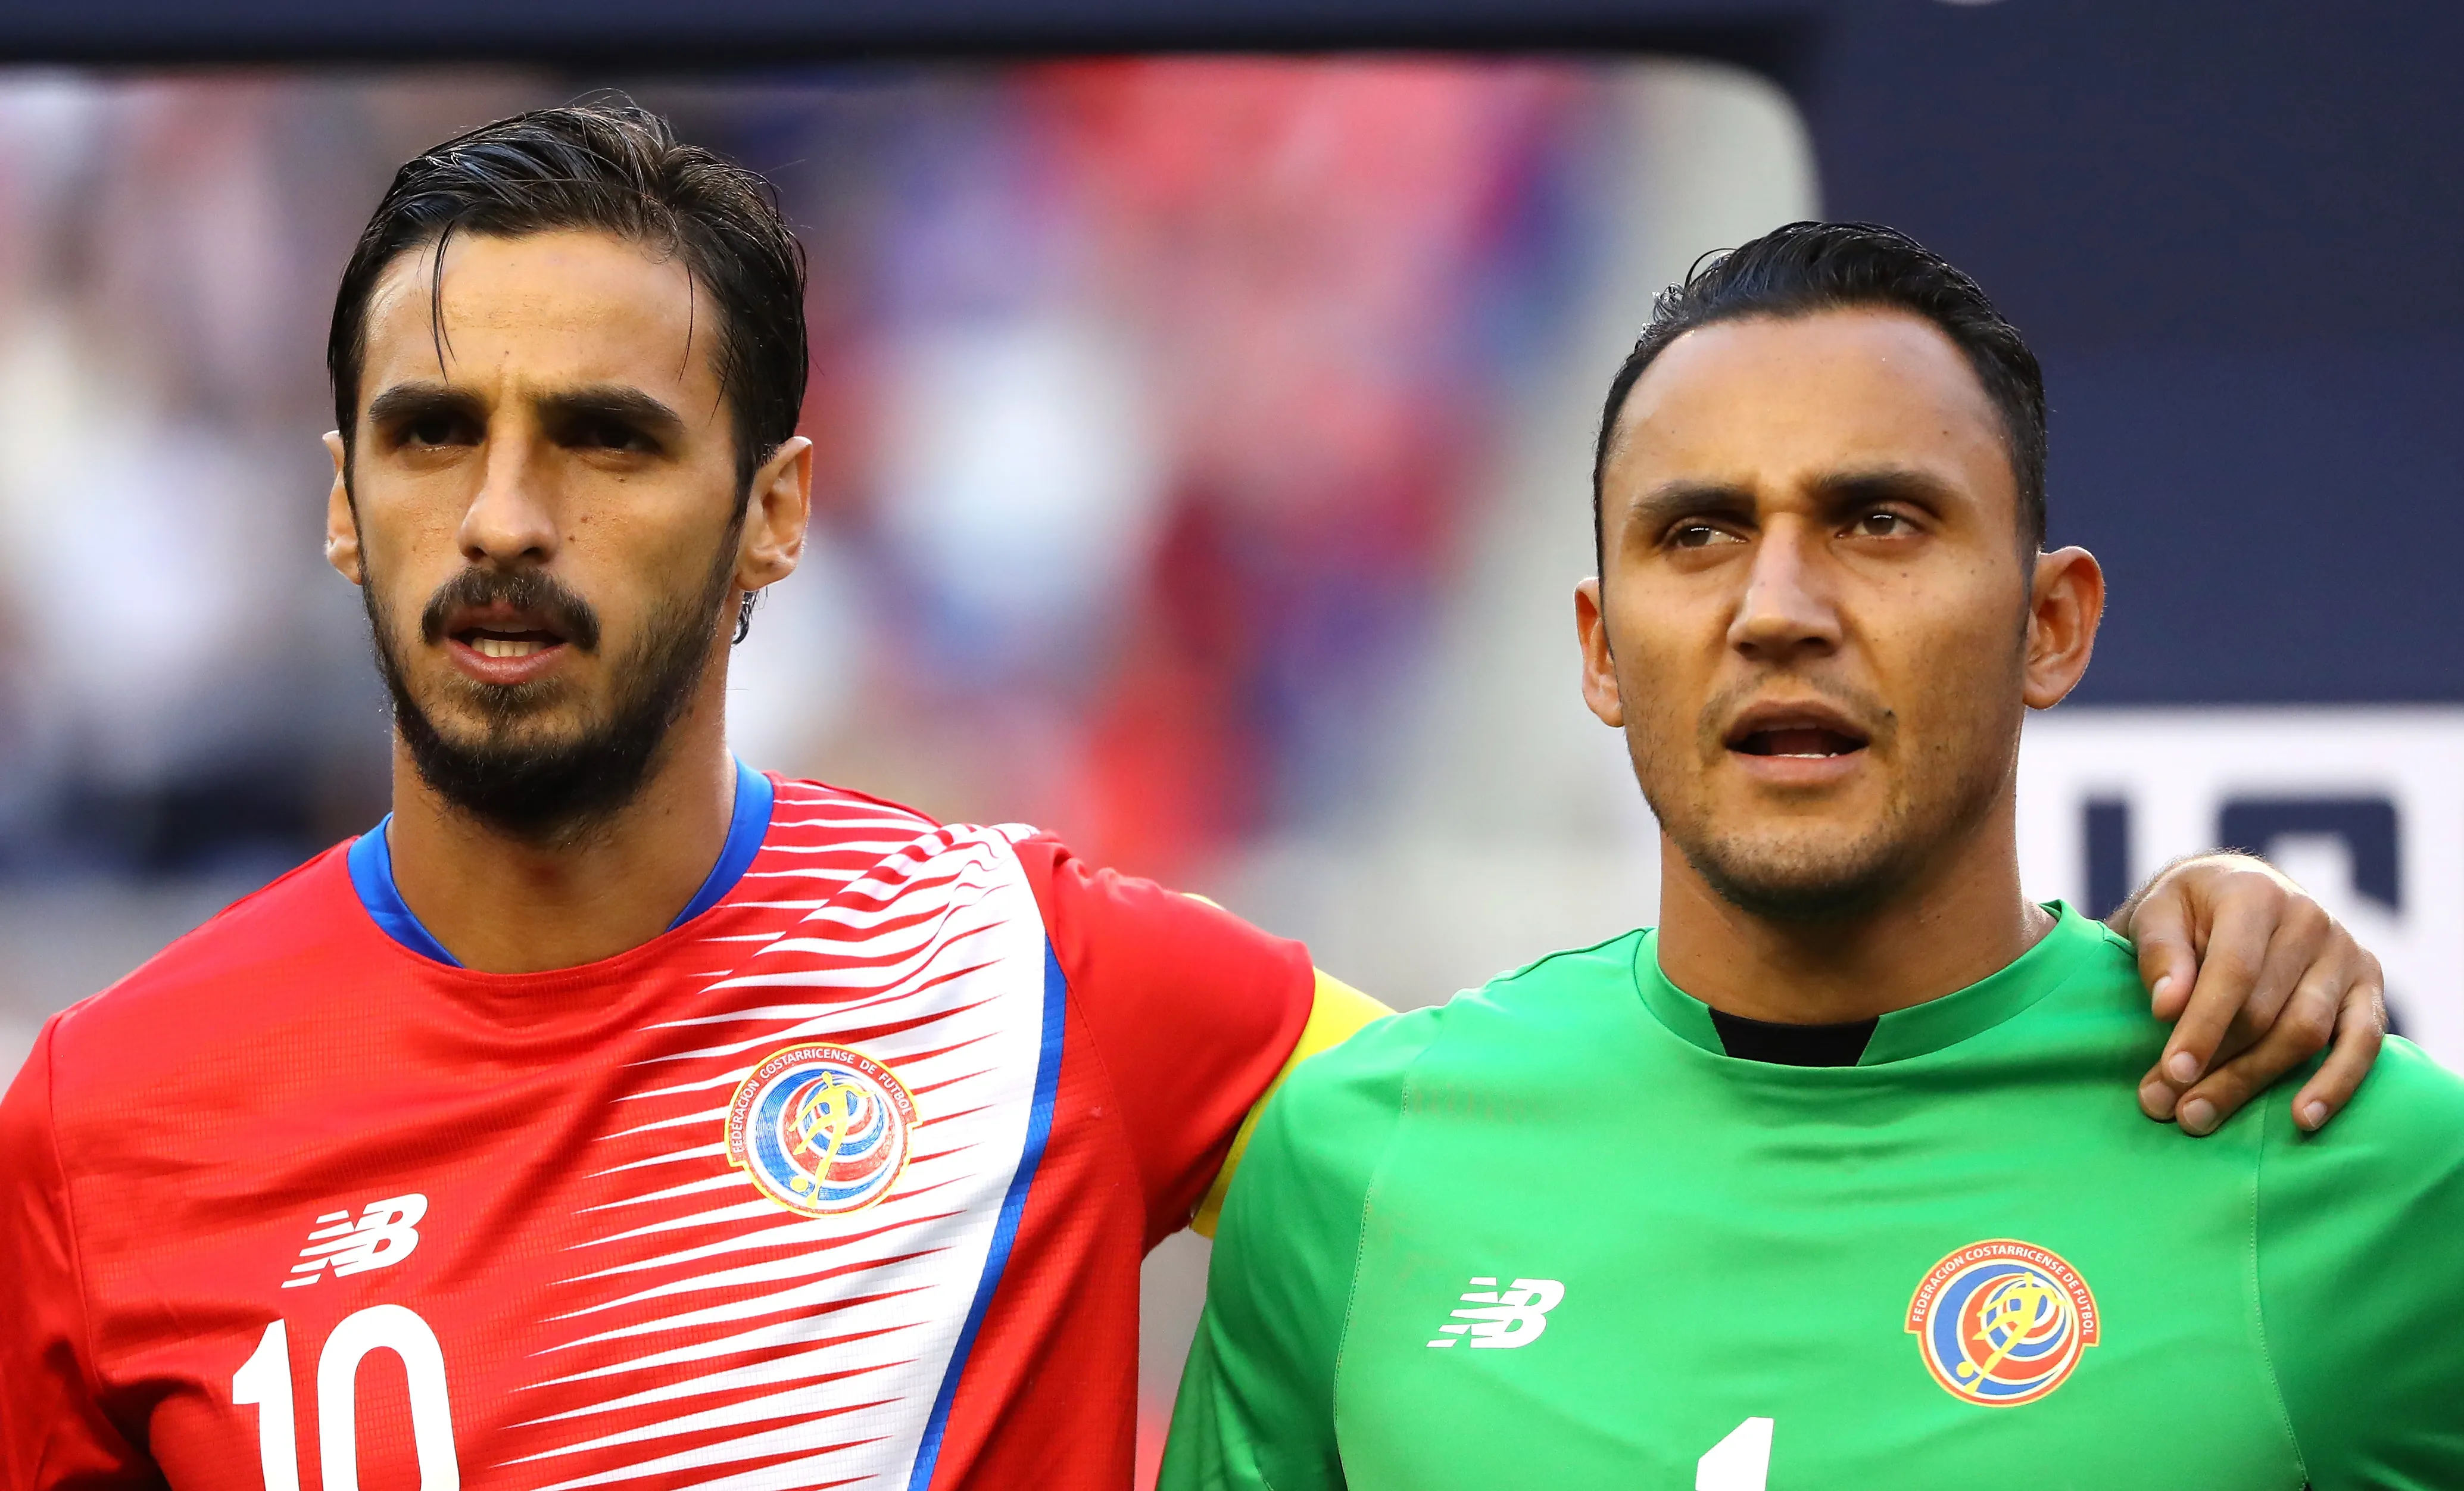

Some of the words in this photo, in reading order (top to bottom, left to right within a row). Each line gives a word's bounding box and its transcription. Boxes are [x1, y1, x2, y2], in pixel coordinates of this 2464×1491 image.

[732, 1080, 760, 1153] FEDERACION
[759, 1048, 856, 1080] COSTARRICENSE
[859, 1059, 878, 1074] DE
[878, 1072, 913, 1116] FUTBOL
[1912, 1255, 1965, 1322] FEDERACION
[1965, 1244, 2066, 1276] COSTARRICENSE
[2062, 1272, 2079, 1289] DE
[2072, 1288, 2094, 1336] FUTBOL
[232, 1303, 461, 1491] 10
